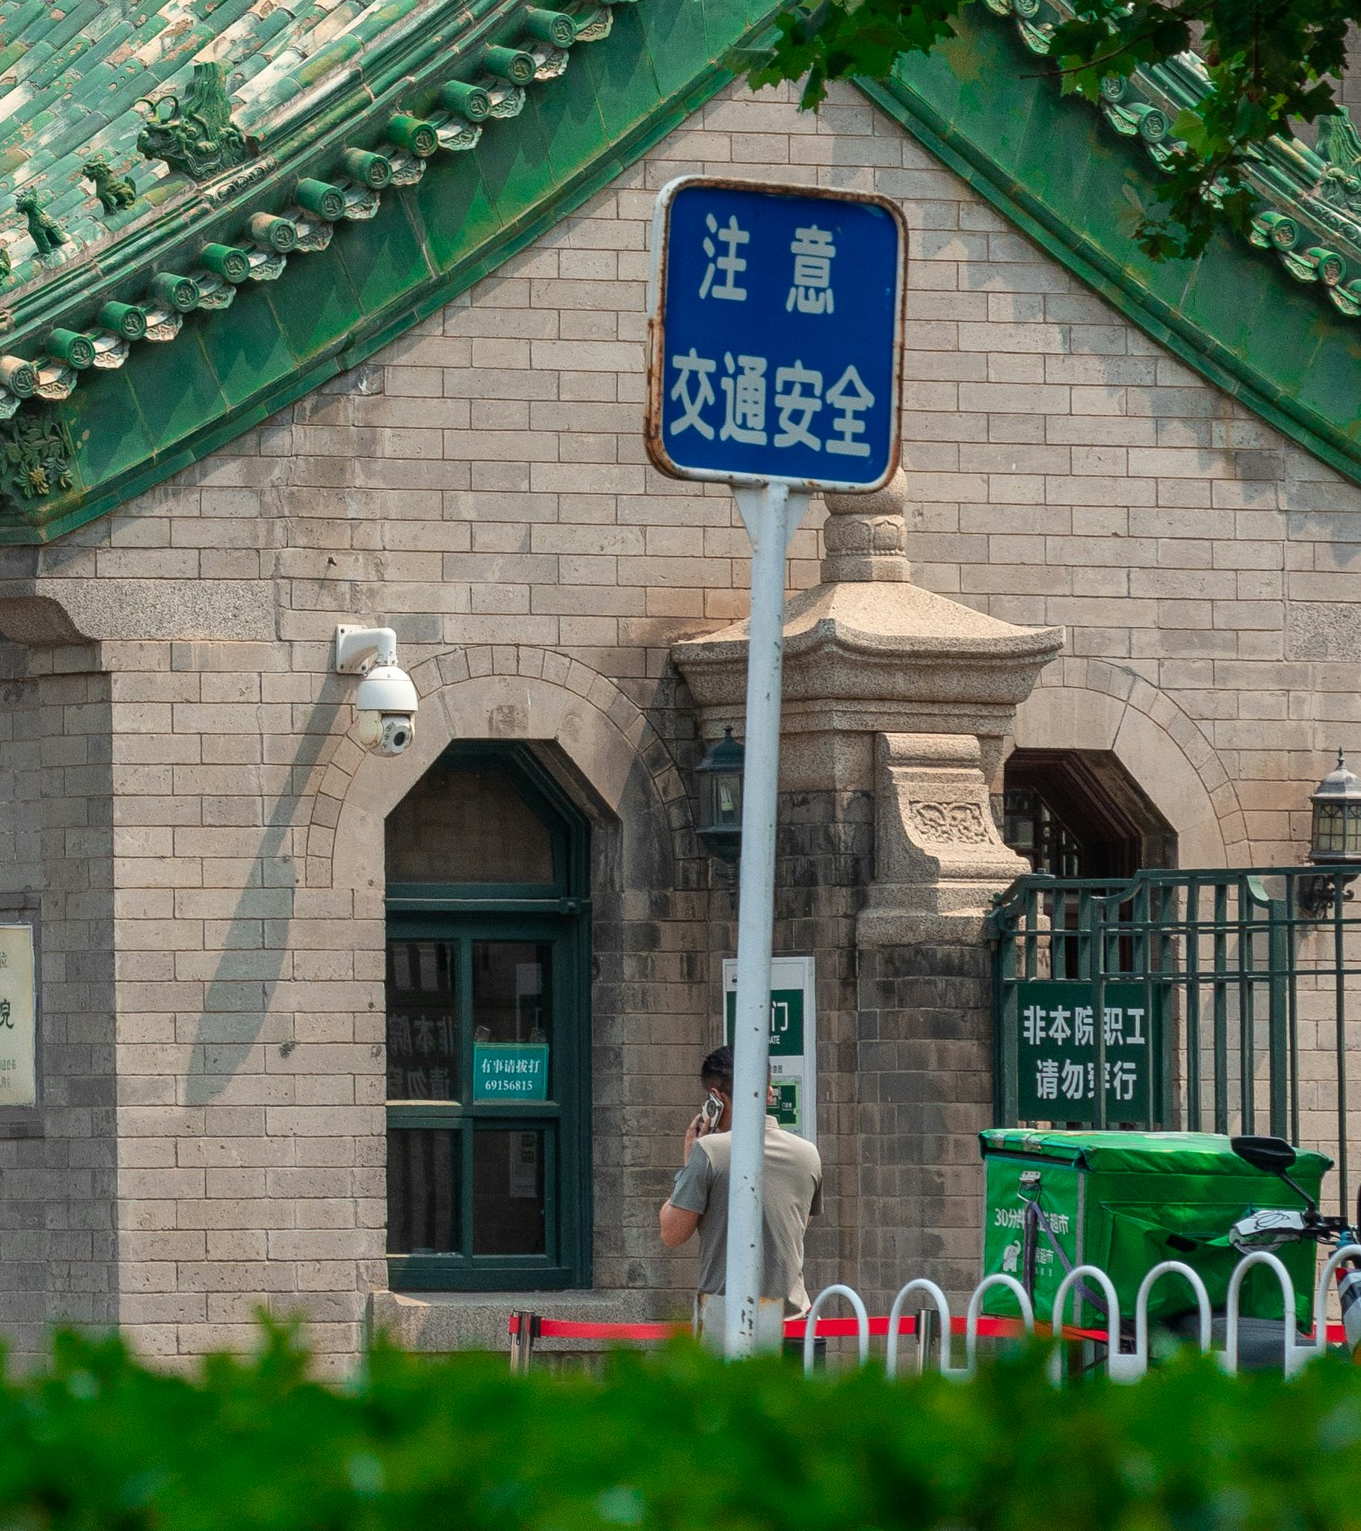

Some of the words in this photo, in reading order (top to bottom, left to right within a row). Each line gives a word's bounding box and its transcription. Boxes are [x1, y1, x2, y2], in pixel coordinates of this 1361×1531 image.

[698, 212, 837, 315] 注意
[669, 347, 876, 458] 交通安全
[1023, 1005, 1146, 1046] 非本院职工
[484, 1079, 534, 1091] 69156815
